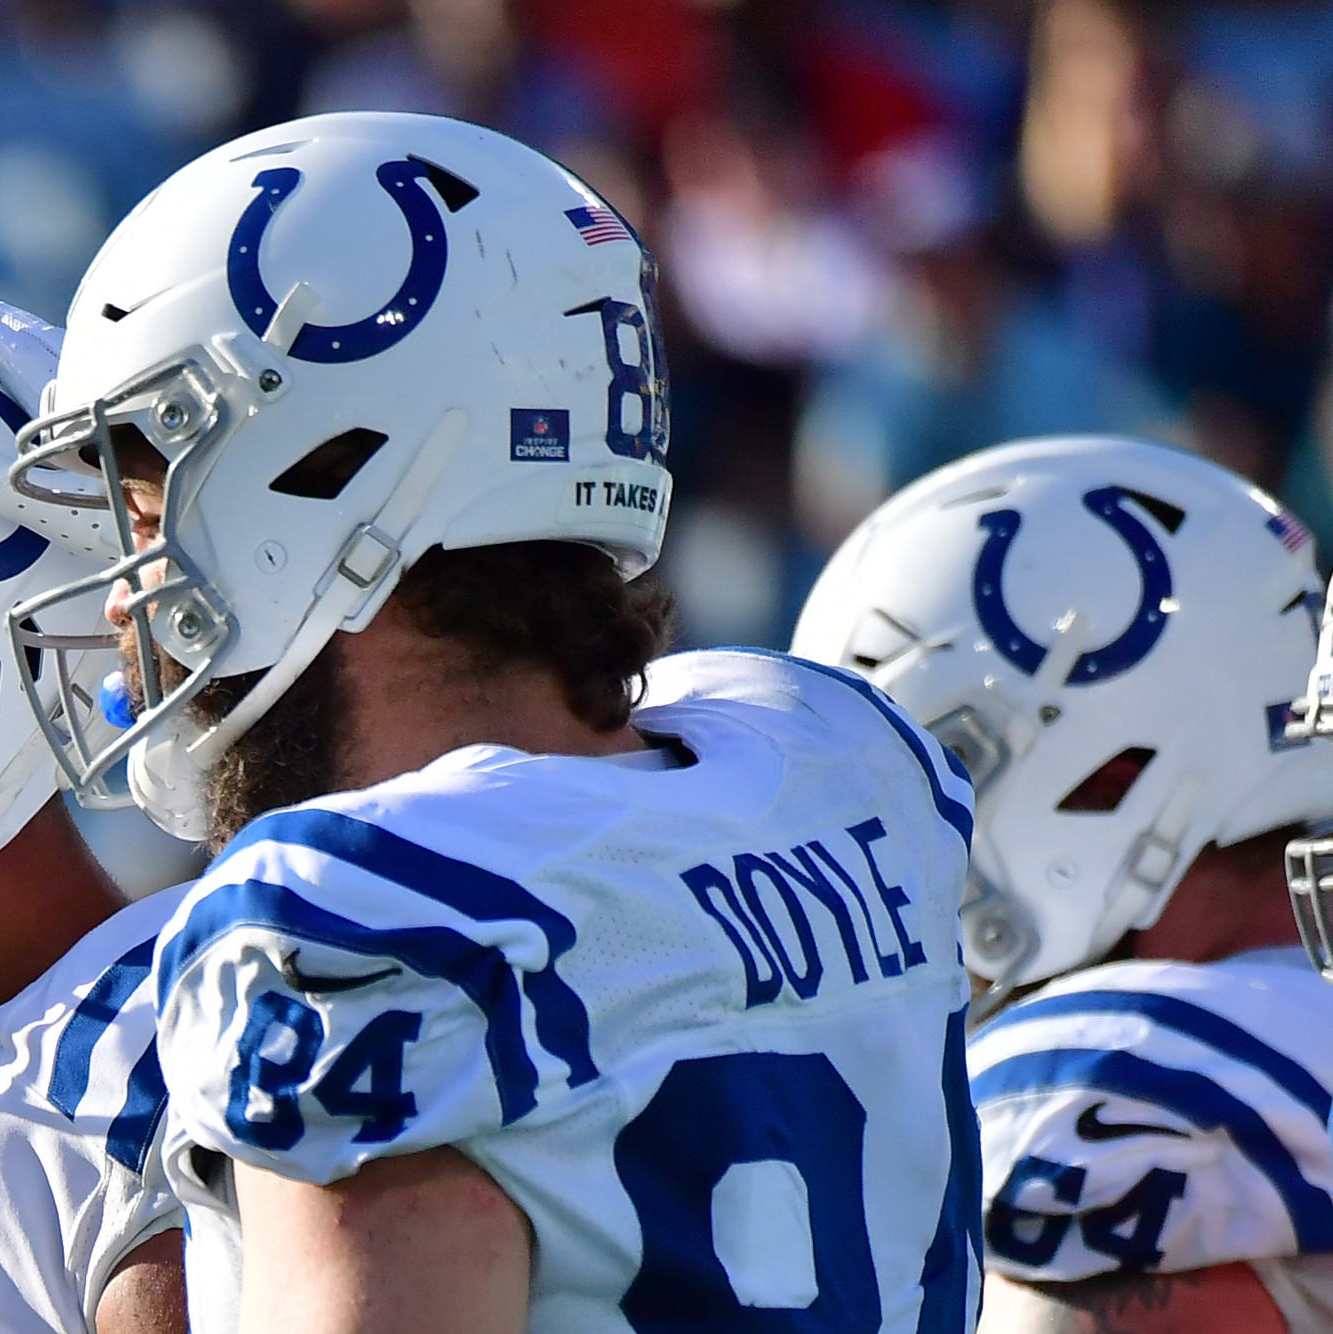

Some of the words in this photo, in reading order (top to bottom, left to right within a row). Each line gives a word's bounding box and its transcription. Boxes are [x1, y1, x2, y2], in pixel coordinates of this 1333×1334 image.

[515, 445, 566, 458] CHANGE
[575, 482, 596, 507] IT
[603, 482, 658, 514] TAKES
[679, 816, 928, 1011] DOYLE
[225, 990, 423, 1152] 84
[984, 1155, 1188, 1274] 64
